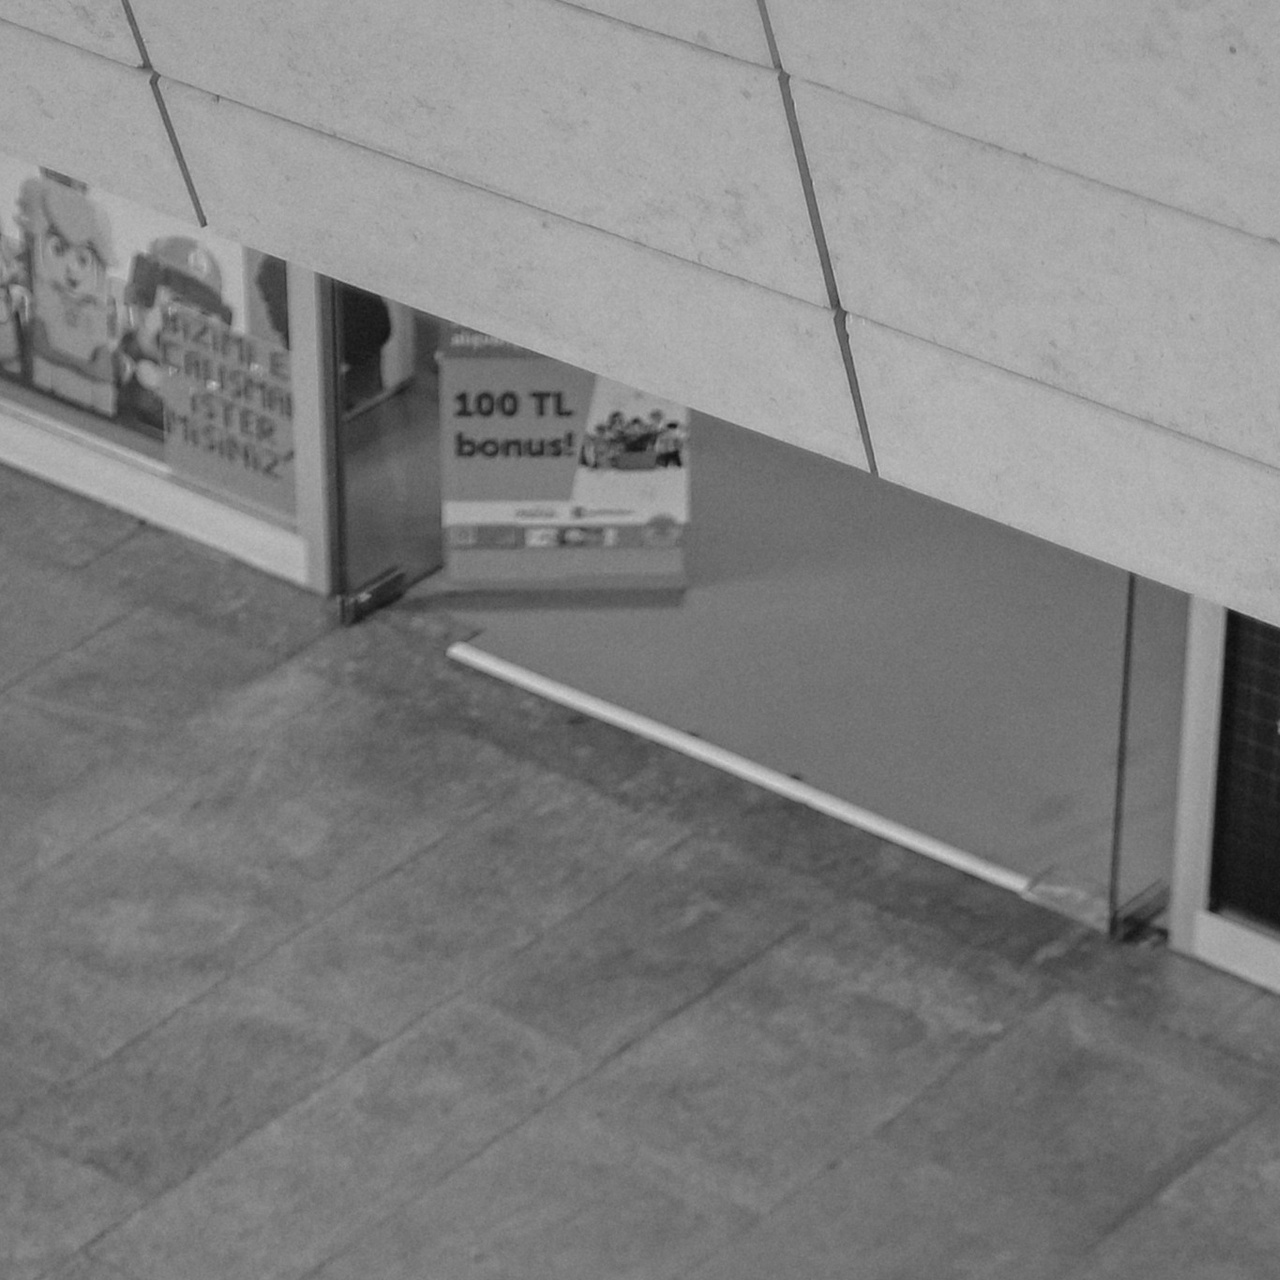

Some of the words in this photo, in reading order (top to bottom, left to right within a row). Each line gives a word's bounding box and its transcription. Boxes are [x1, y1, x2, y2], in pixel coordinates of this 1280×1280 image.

[454, 390, 520, 418] 100
[529, 389, 575, 418] TL
[454, 430, 575, 458] bonus!
